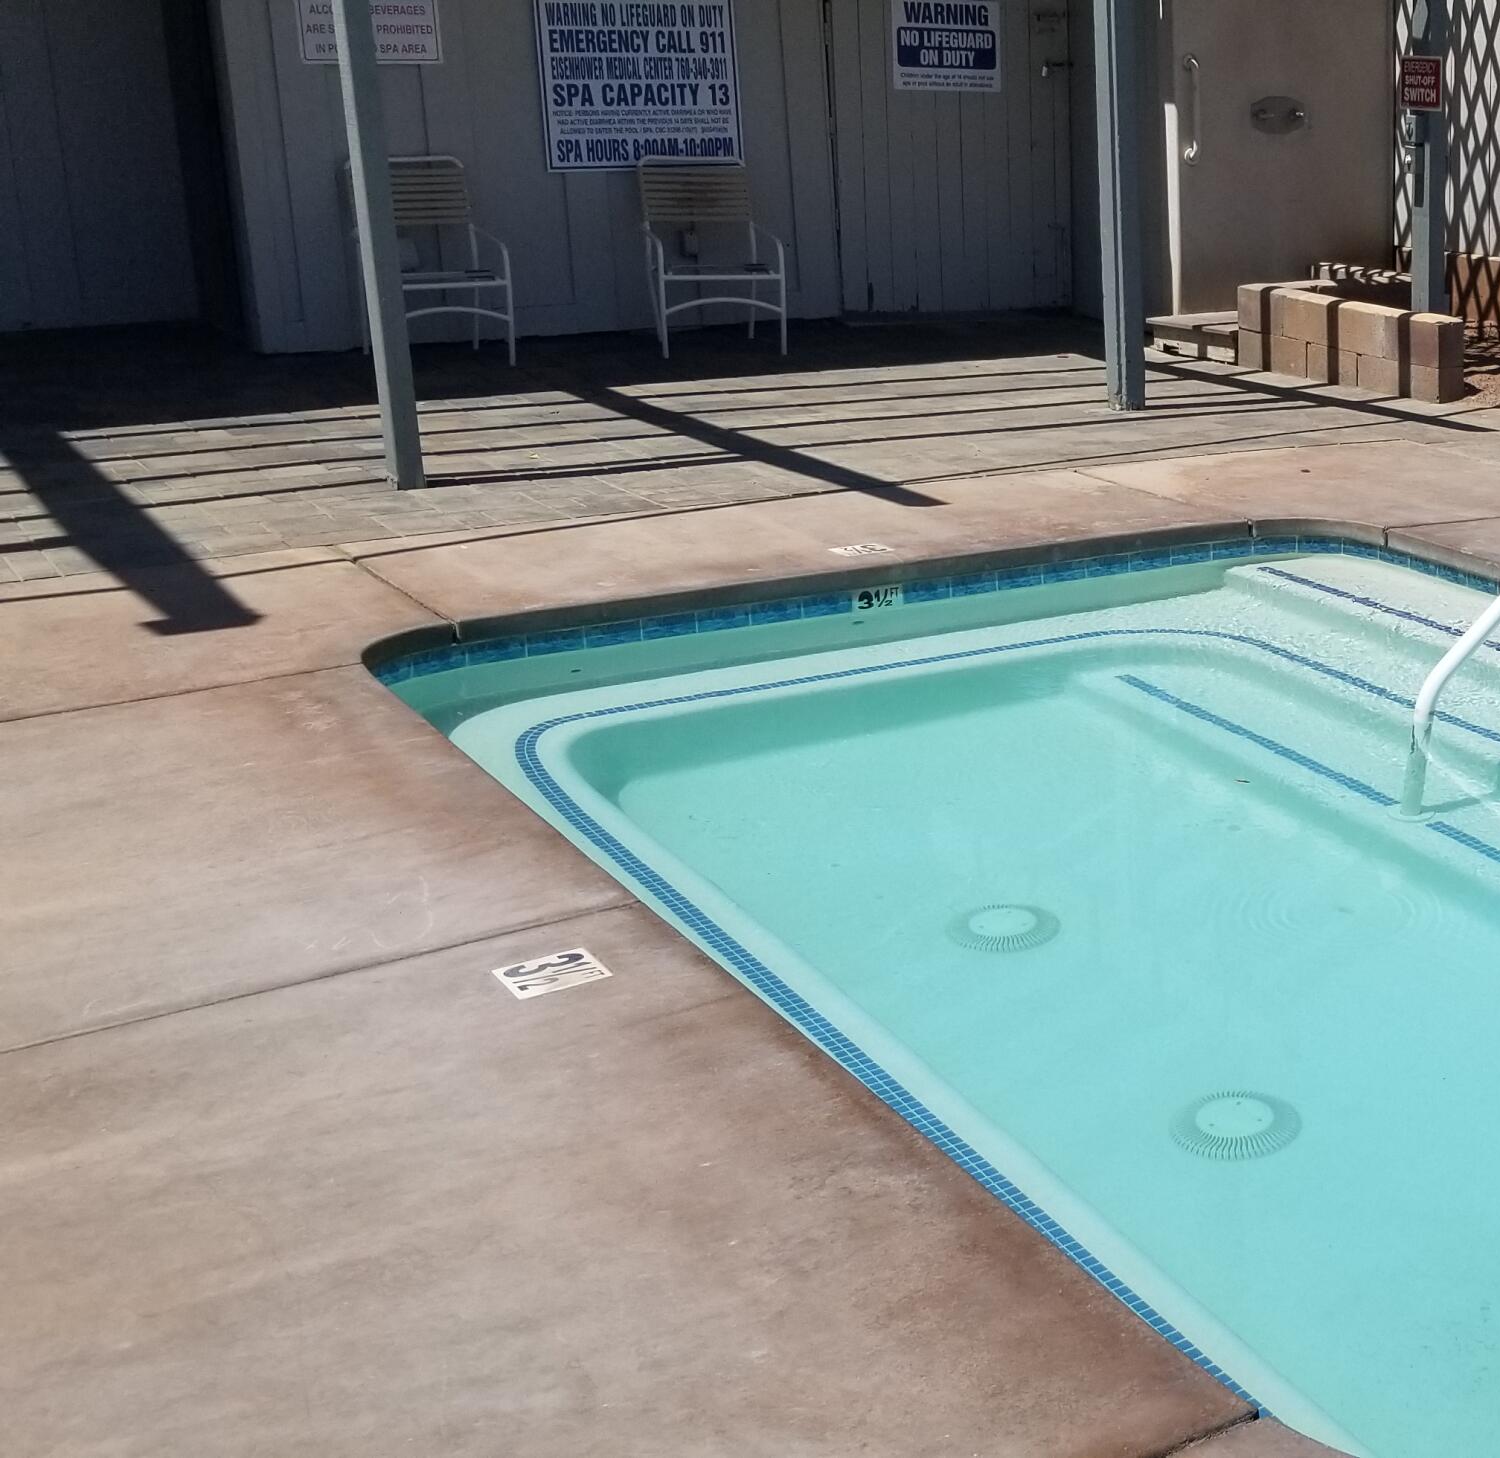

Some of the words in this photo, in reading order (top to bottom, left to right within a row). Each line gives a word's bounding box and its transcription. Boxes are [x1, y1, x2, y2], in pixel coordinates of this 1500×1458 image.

[545, 3, 597, 26] WARNING
[601, 3, 616, 26] NO
[620, 4, 676, 27] LIFEGUARD
[681, 4, 695, 27] ON
[700, 5, 723, 28] DUTY
[904, 1, 989, 26] WARNING
[306, 24, 327, 34] ARE
[377, 24, 433, 35] PROHIBITED
[548, 29, 650, 53] EMERGENCY
[655, 30, 695, 53] CALL
[700, 30, 726, 53] 911
[900, 29, 919, 46] NO
[923, 30, 993, 49] LIFEGUARD
[316, 44, 326, 54] IN
[380, 44, 399, 54] SPA
[402, 44, 427, 54] AREA
[920, 49, 939, 66] ON
[943, 50, 975, 67] DUTY
[551, 57, 603, 80] EISENHOWER
[606, 57, 642, 80] MEDICAL
[644, 57, 674, 80] CENTER
[676, 57, 728, 80] 760-340-3911
[1405, 75, 1436, 86] SHUT-OFF
[553, 83, 594, 107] SPA
[601, 83, 699, 107] CAPACITY
[708, 83, 730, 106] 13
[1403, 87, 1437, 103] SWITCH
[557, 139, 583, 163] SPA
[586, 139, 629, 162] HOURS
[633, 137, 734, 161] 8:00AM-10:00PM
